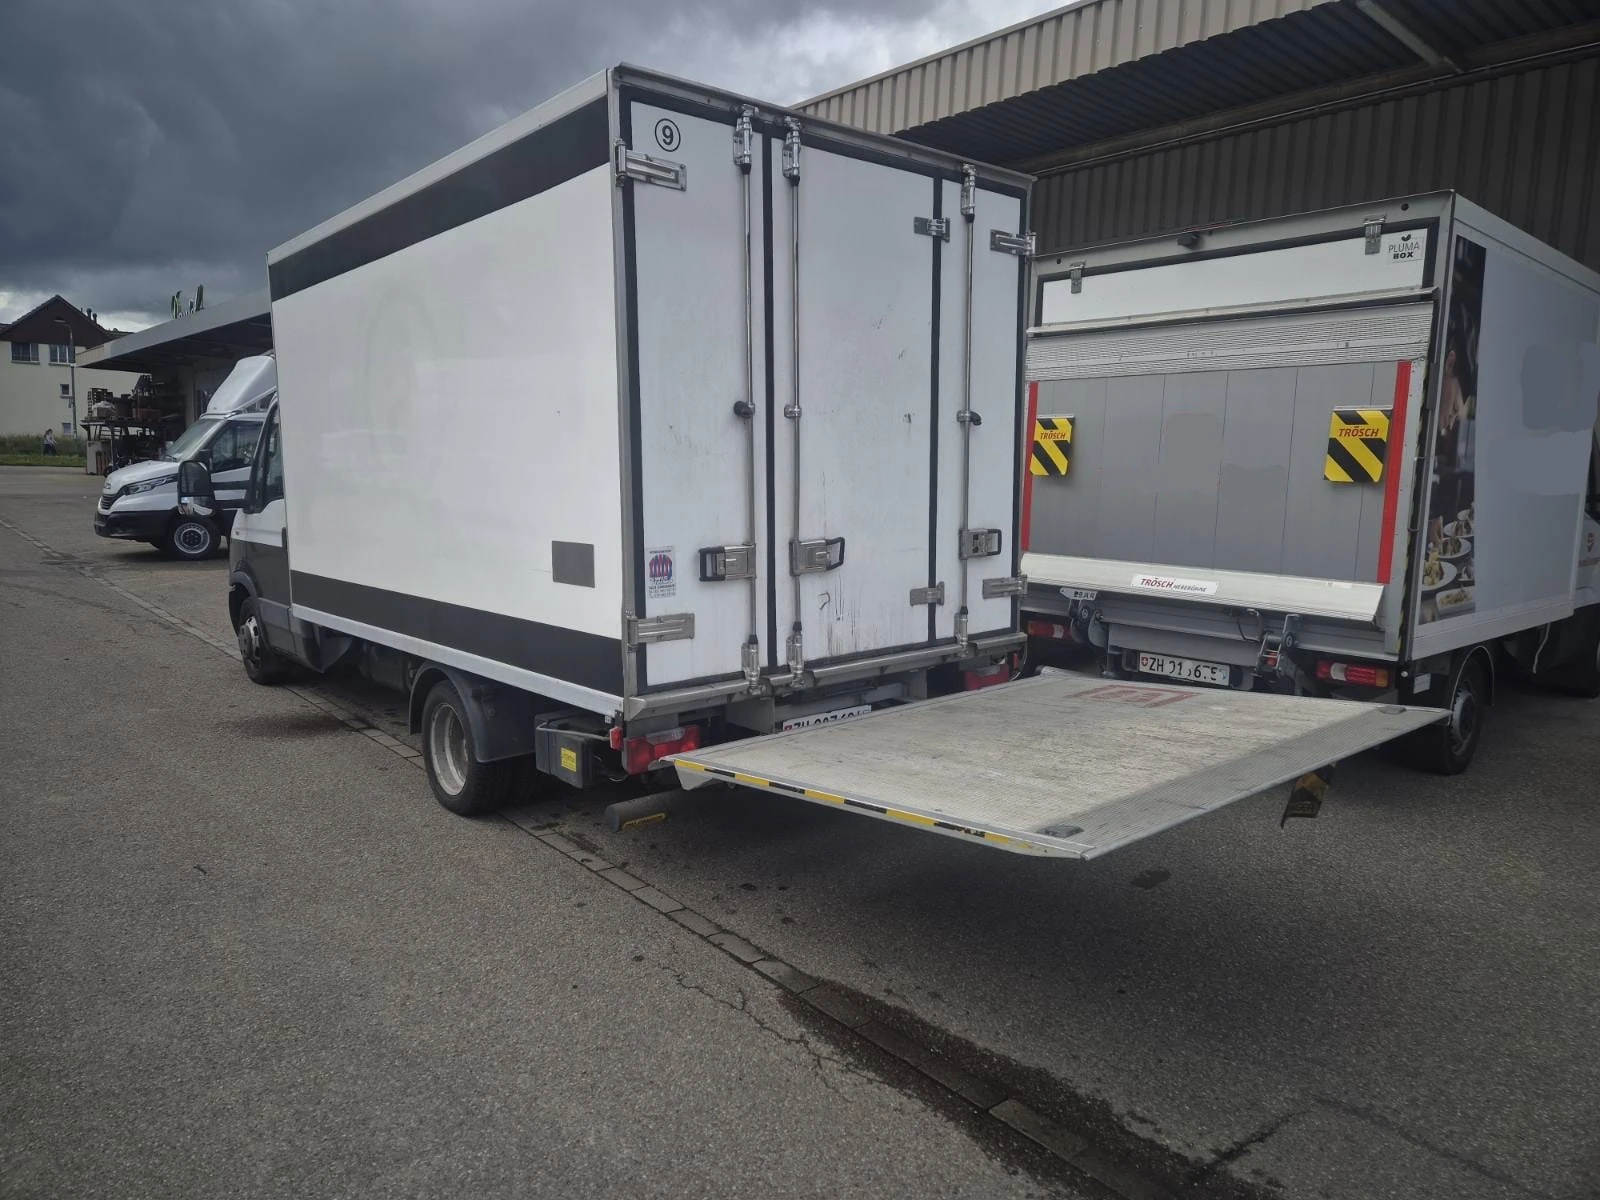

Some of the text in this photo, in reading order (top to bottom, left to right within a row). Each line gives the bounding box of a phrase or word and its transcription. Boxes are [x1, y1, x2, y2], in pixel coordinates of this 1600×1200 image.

[662, 125, 674, 146] 9
[1388, 241, 1420, 253] PLUMA
[1393, 251, 1414, 260] BOX
[1040, 430, 1066, 440] TRÖSCH
[1338, 425, 1380, 438] TRÖSCH
[1140, 577, 1174, 589] TRÖSCH
[1149, 657, 1164, 673] ZH
